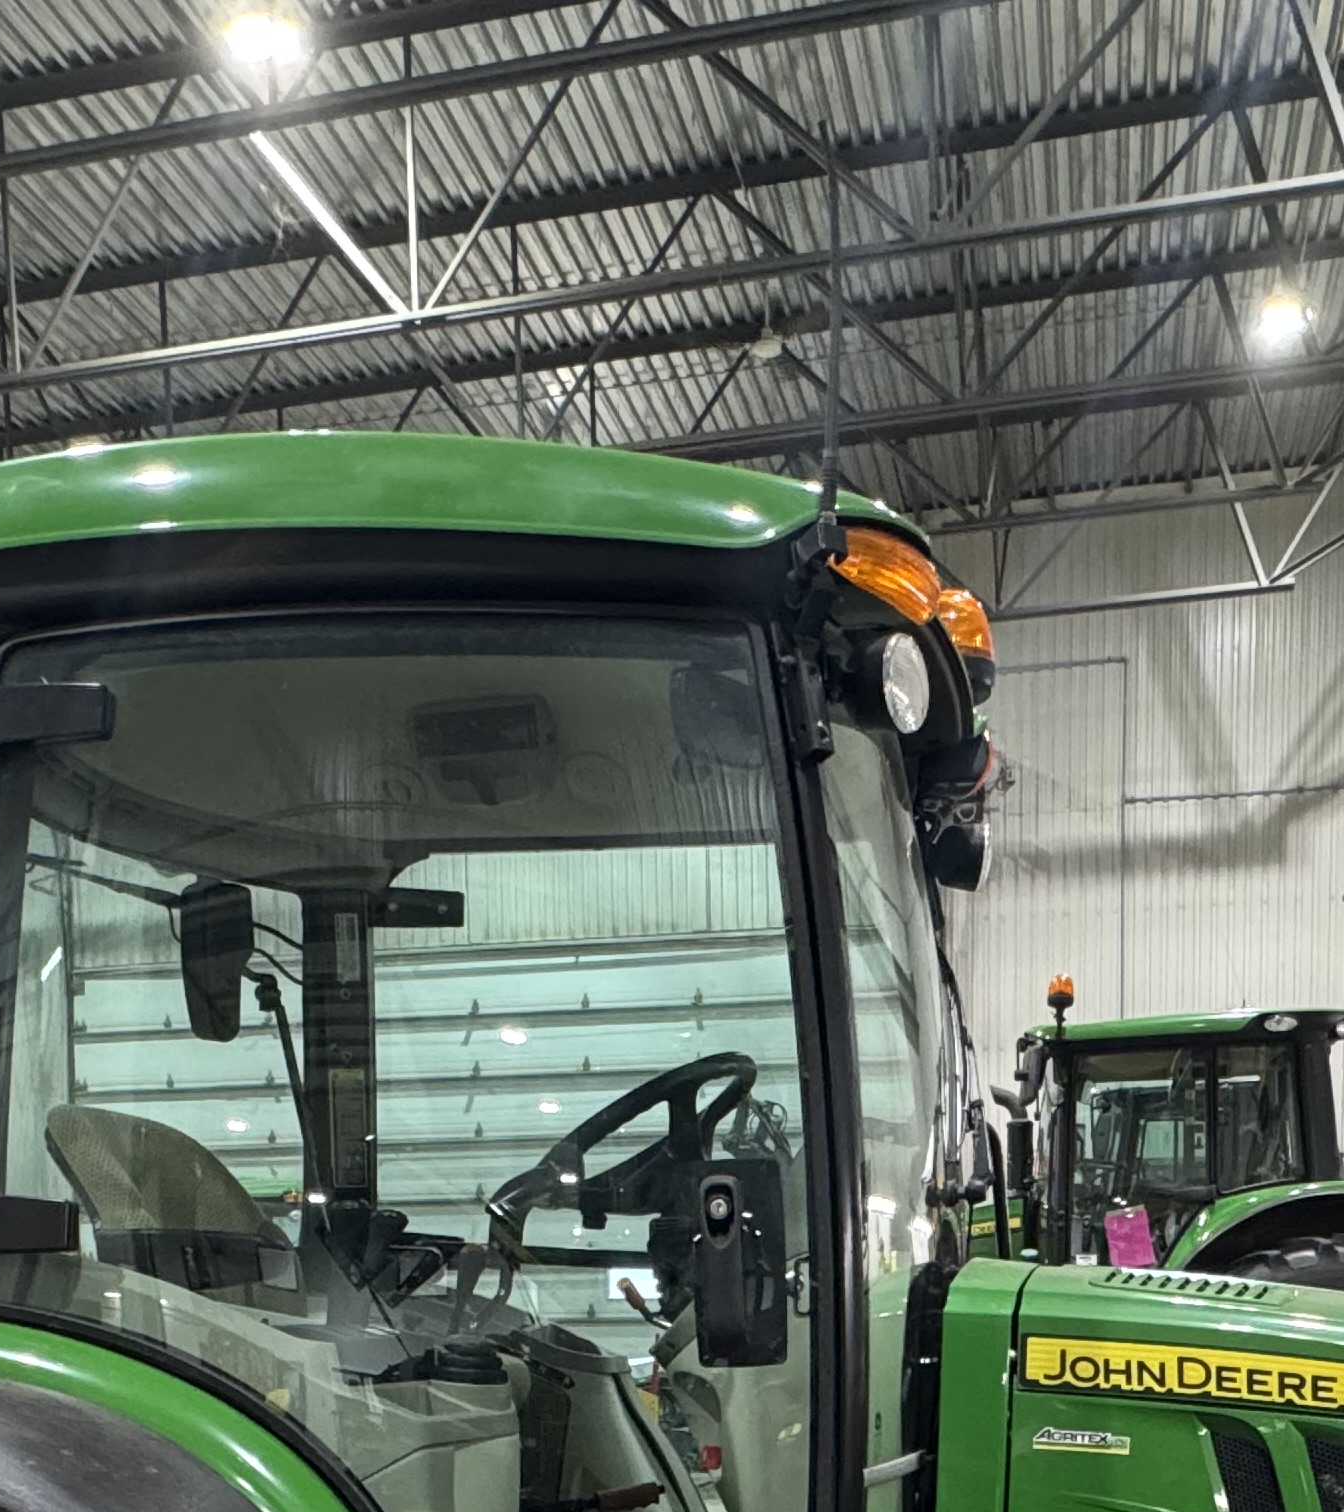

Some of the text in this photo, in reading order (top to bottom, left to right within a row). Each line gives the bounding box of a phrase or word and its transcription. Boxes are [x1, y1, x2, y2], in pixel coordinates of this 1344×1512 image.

[1042, 1348, 1339, 1404] JOHN DEERE
[1035, 1428, 1109, 1446] AGRITEX
